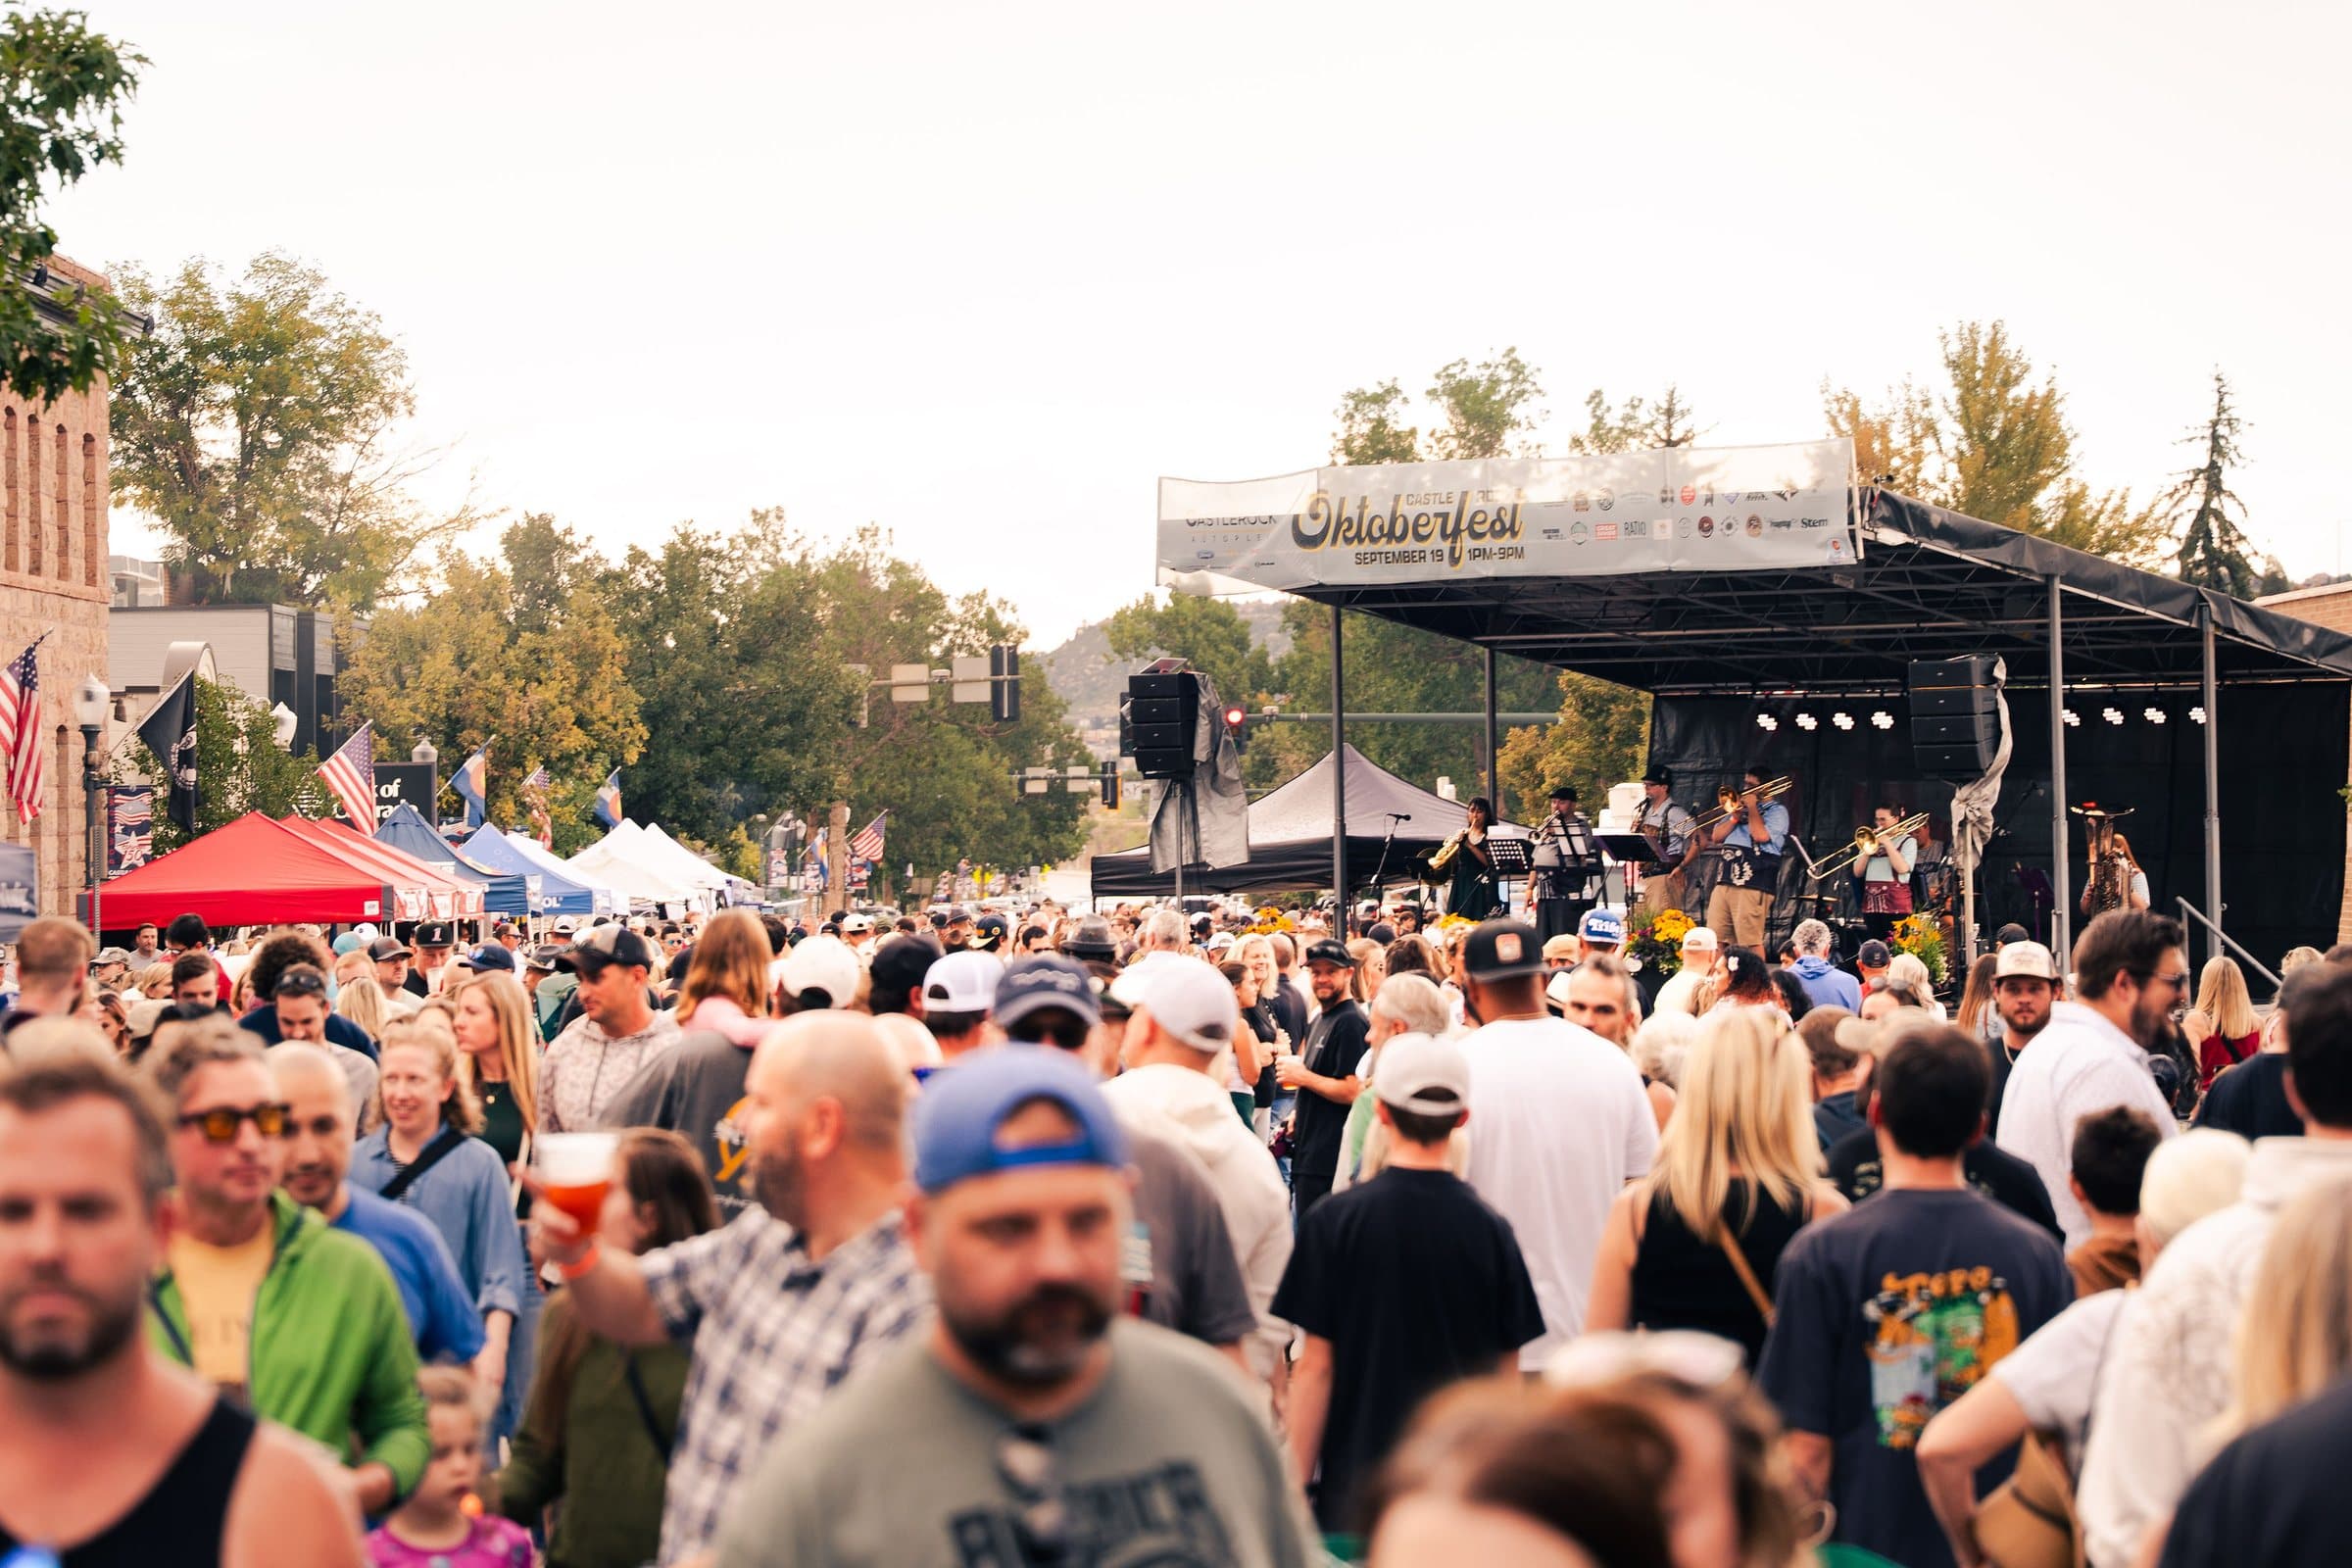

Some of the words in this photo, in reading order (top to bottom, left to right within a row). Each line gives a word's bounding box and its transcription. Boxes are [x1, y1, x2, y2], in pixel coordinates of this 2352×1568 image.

[1406, 491, 1453, 507] CASTLE
[1291, 488, 1526, 571] Oktoberfest
[1800, 517, 1828, 528] Stem
[1192, 533, 1263, 542] AUTOPLE
[1354, 549, 1426, 565] SEPTEMBER
[1430, 549, 1444, 564] 19
[1467, 546, 1525, 562] 1PM-9PM
[380, 777, 402, 799] of
[431, 926, 443, 942] 1
